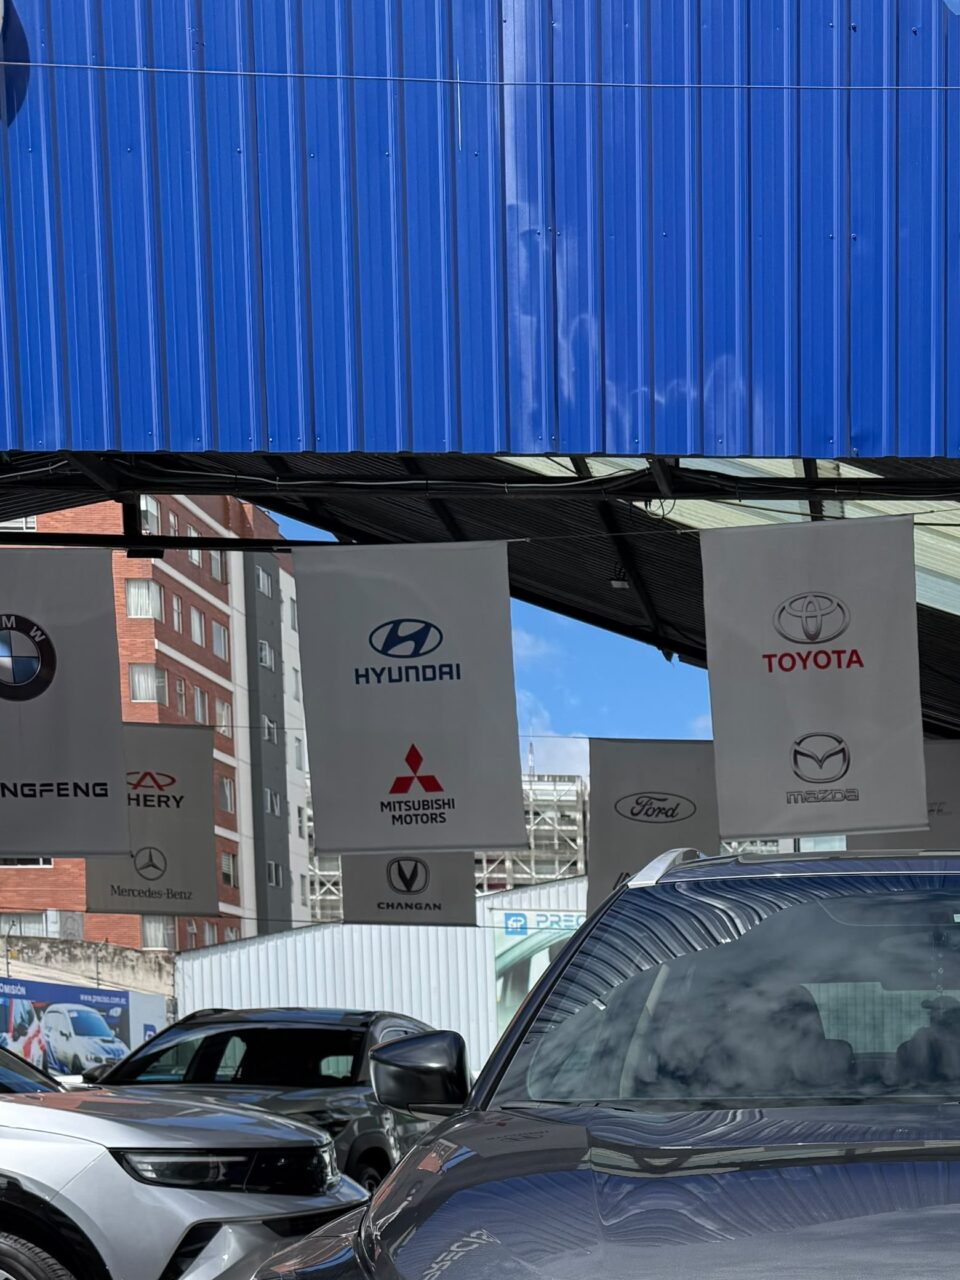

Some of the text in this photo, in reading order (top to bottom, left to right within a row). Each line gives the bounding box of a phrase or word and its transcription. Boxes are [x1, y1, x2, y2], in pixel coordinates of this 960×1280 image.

[761, 649, 865, 673] TOYOTA
[354, 663, 462, 685] HYUNDAI
[380, 798, 456, 813] MITSUBISHI
[630, 795, 681, 819] Ford
[391, 812, 447, 825] MOTORS
[376, 901, 442, 911] CHANGAN
